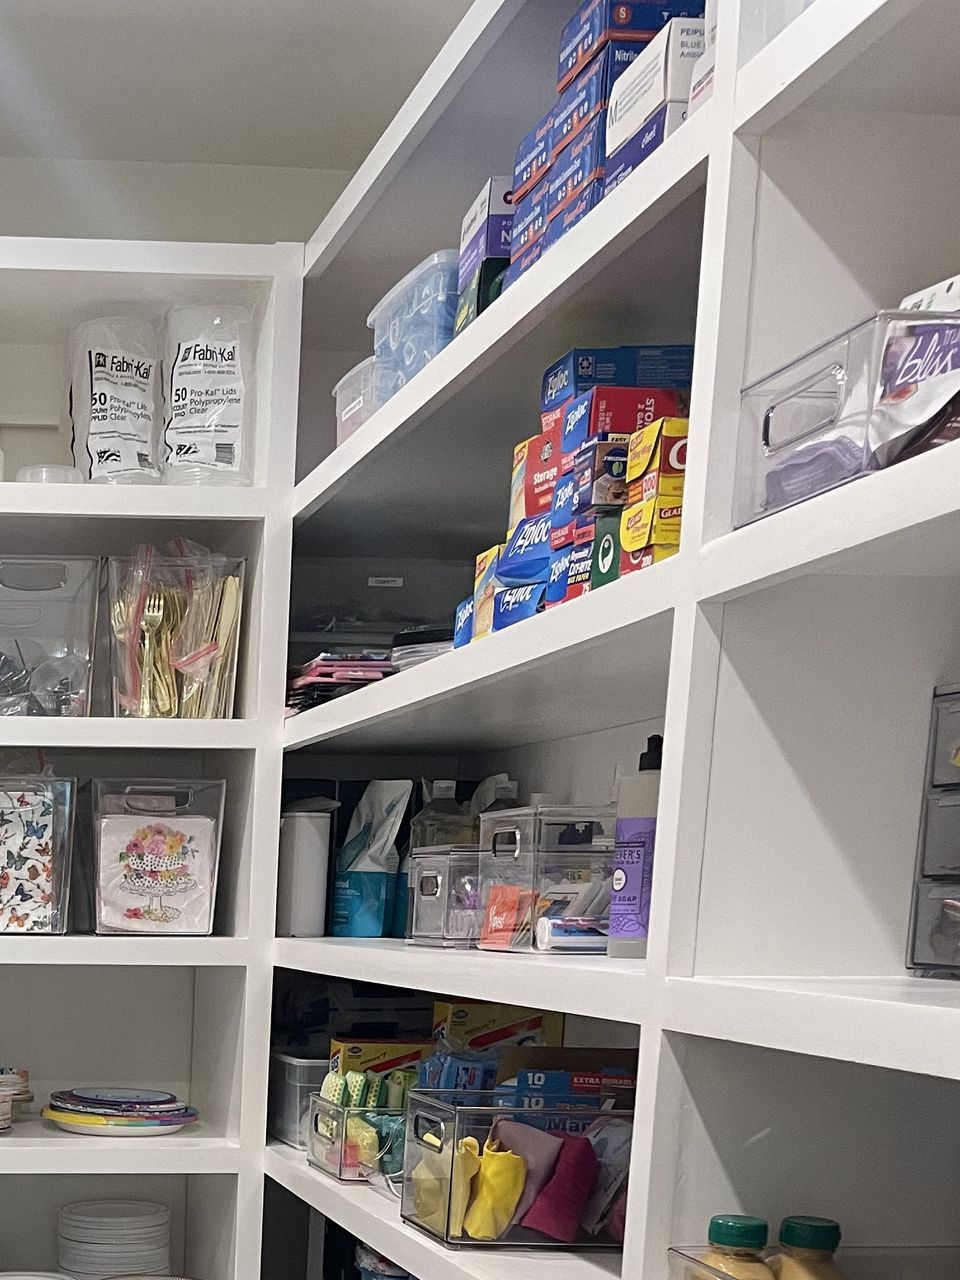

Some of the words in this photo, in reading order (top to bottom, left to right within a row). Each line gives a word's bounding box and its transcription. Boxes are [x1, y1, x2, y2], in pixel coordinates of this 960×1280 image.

[193, 344, 237, 362] Fabri-Kal
[895, 332, 958, 386] bliss
[111, 356, 152, 379] Fabri-Kal
[92, 392, 108, 406] 50
[174, 387, 188, 403] 50
[222, 388, 237, 396] Lids
[565, 400, 588, 435] Ziploc
[533, 467, 558, 485] Storage
[512, 519, 552, 555] Ziploc
[527, 1073, 546, 1085] 10
[523, 1097, 545, 1109] 10
